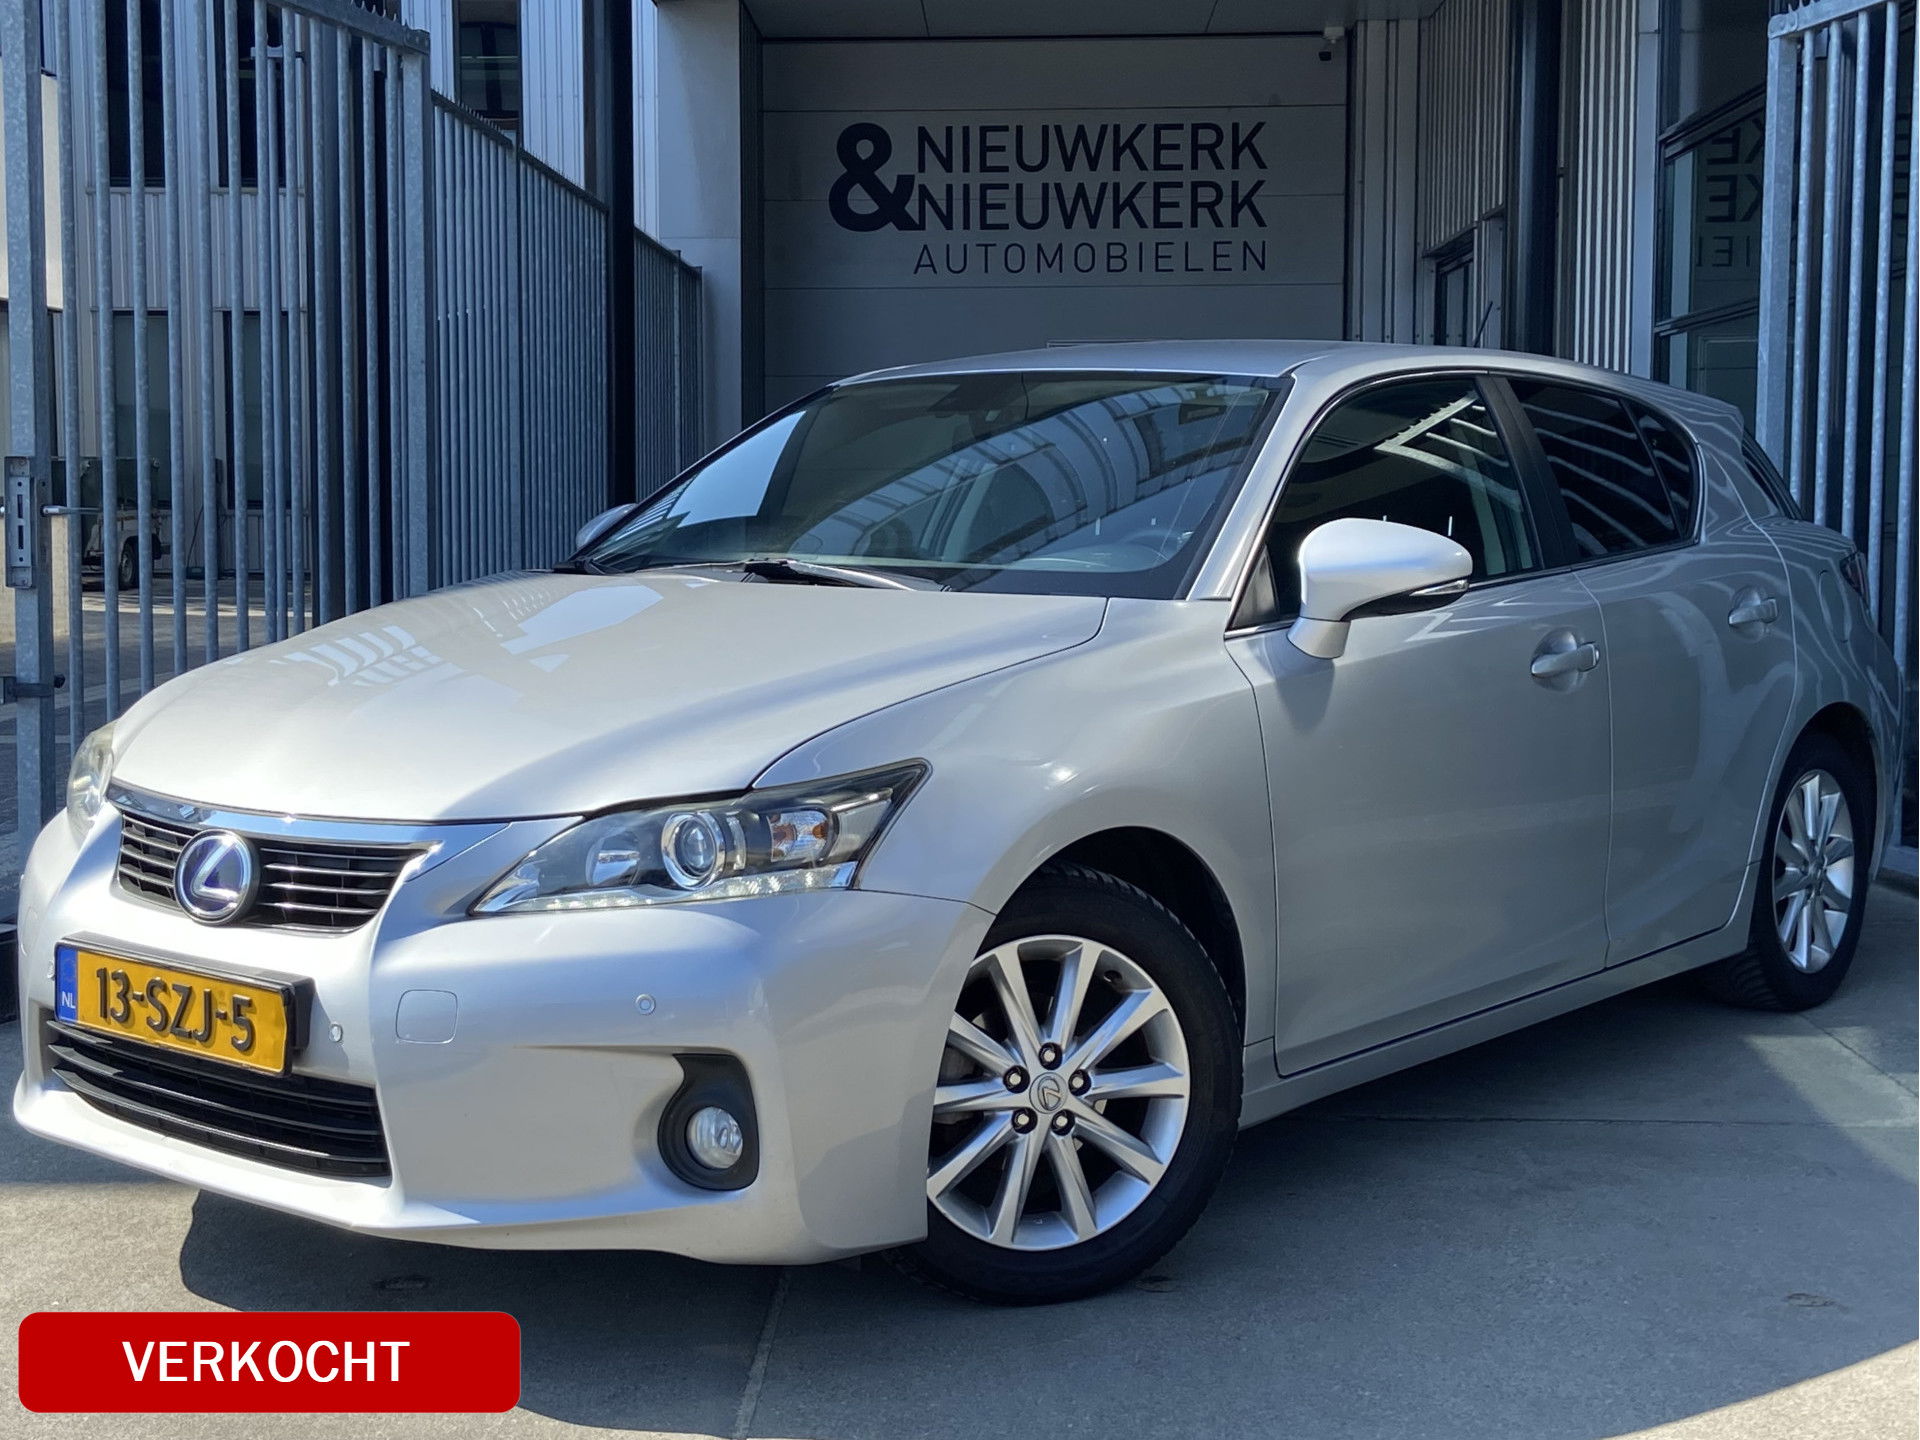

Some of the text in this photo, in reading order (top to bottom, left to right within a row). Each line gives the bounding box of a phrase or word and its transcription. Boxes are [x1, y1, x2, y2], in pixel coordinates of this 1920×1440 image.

[917, 122, 1268, 173] NIEUWKERK
[917, 180, 1268, 231] NIEUWKERK
[913, 240, 1267, 275] AUTOMOBIELEN
[61, 991, 77, 1009] NL
[96, 967, 257, 1051] 13-SZJ-5
